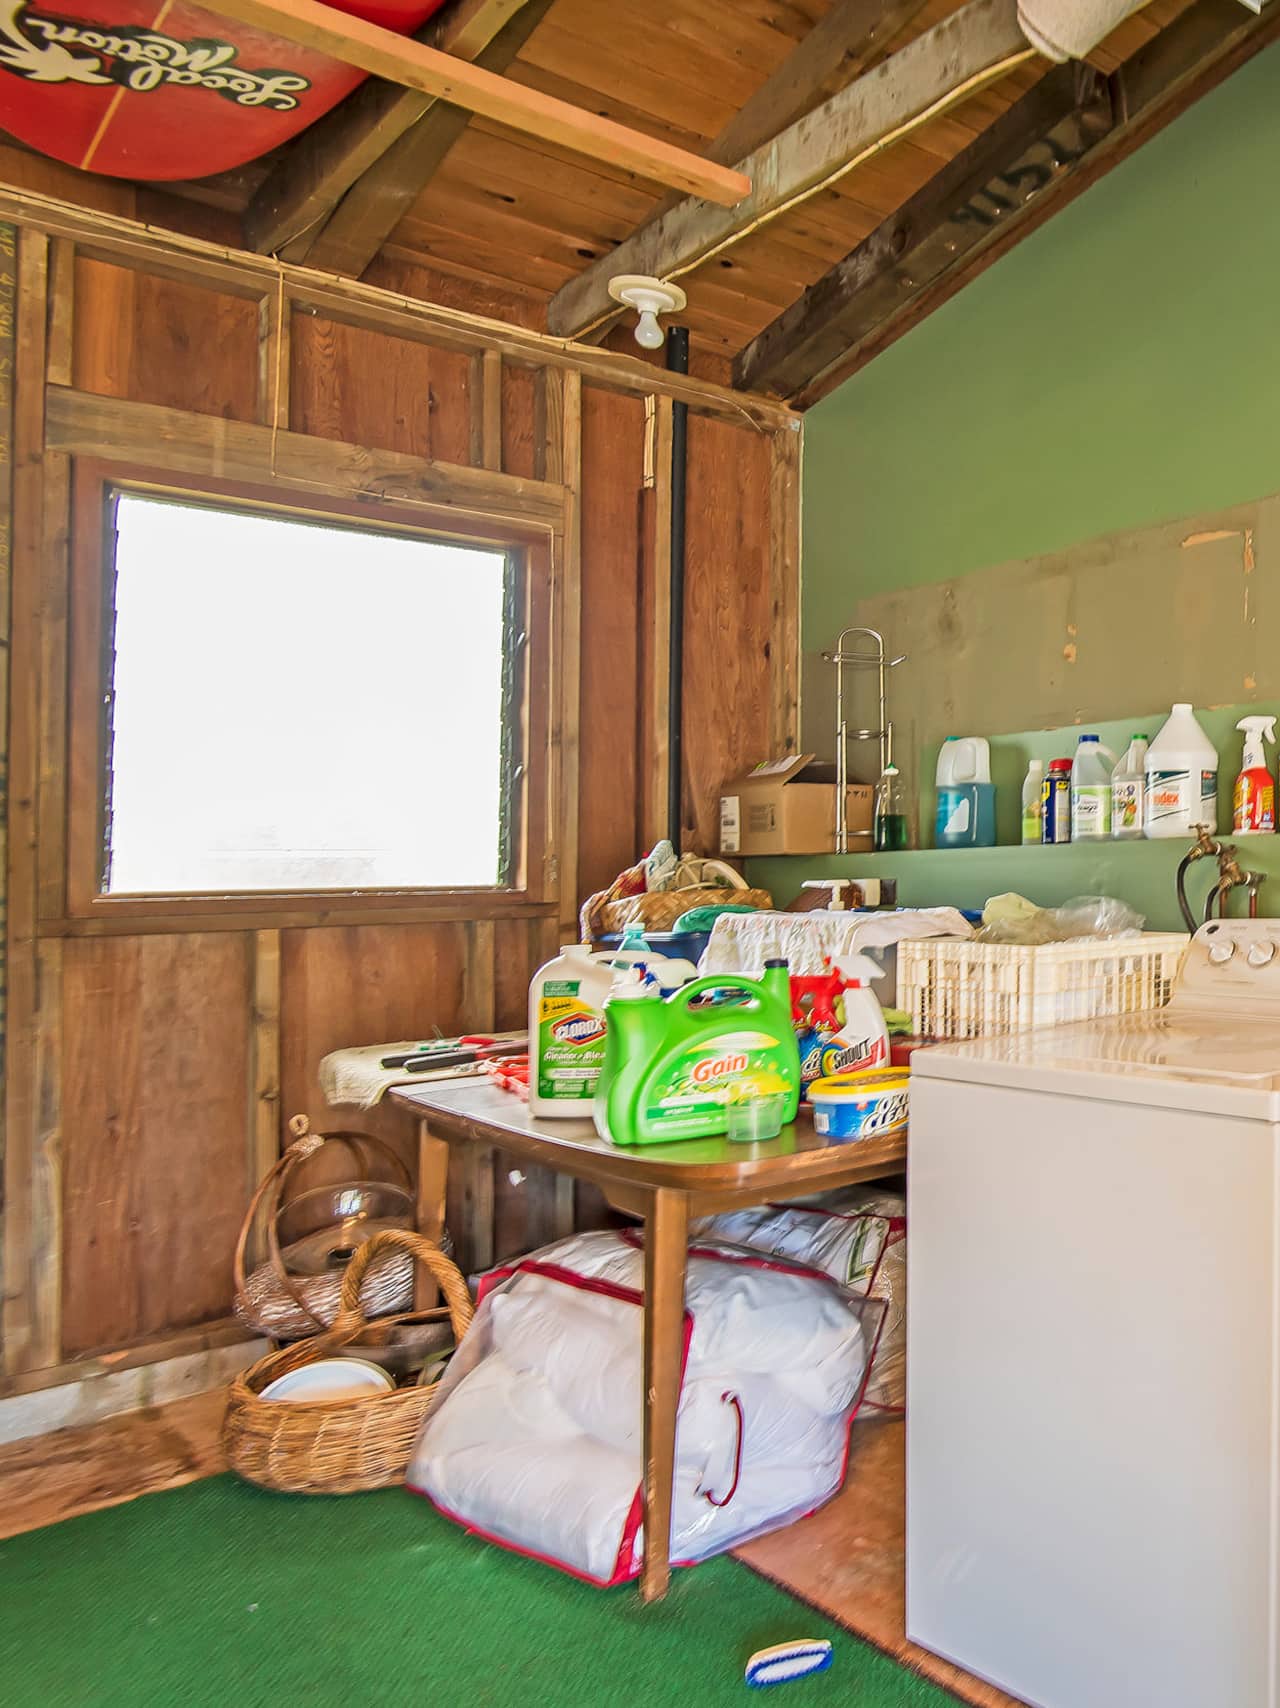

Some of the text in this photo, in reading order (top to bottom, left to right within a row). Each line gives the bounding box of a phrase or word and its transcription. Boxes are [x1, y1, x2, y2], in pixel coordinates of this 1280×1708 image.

[26, 18, 235, 72] Motion
[130, 60, 309, 109] Local
[555, 1016, 603, 1041] CLOROX
[694, 1054, 747, 1082] Gain
[833, 1037, 871, 1069] SHOUT
